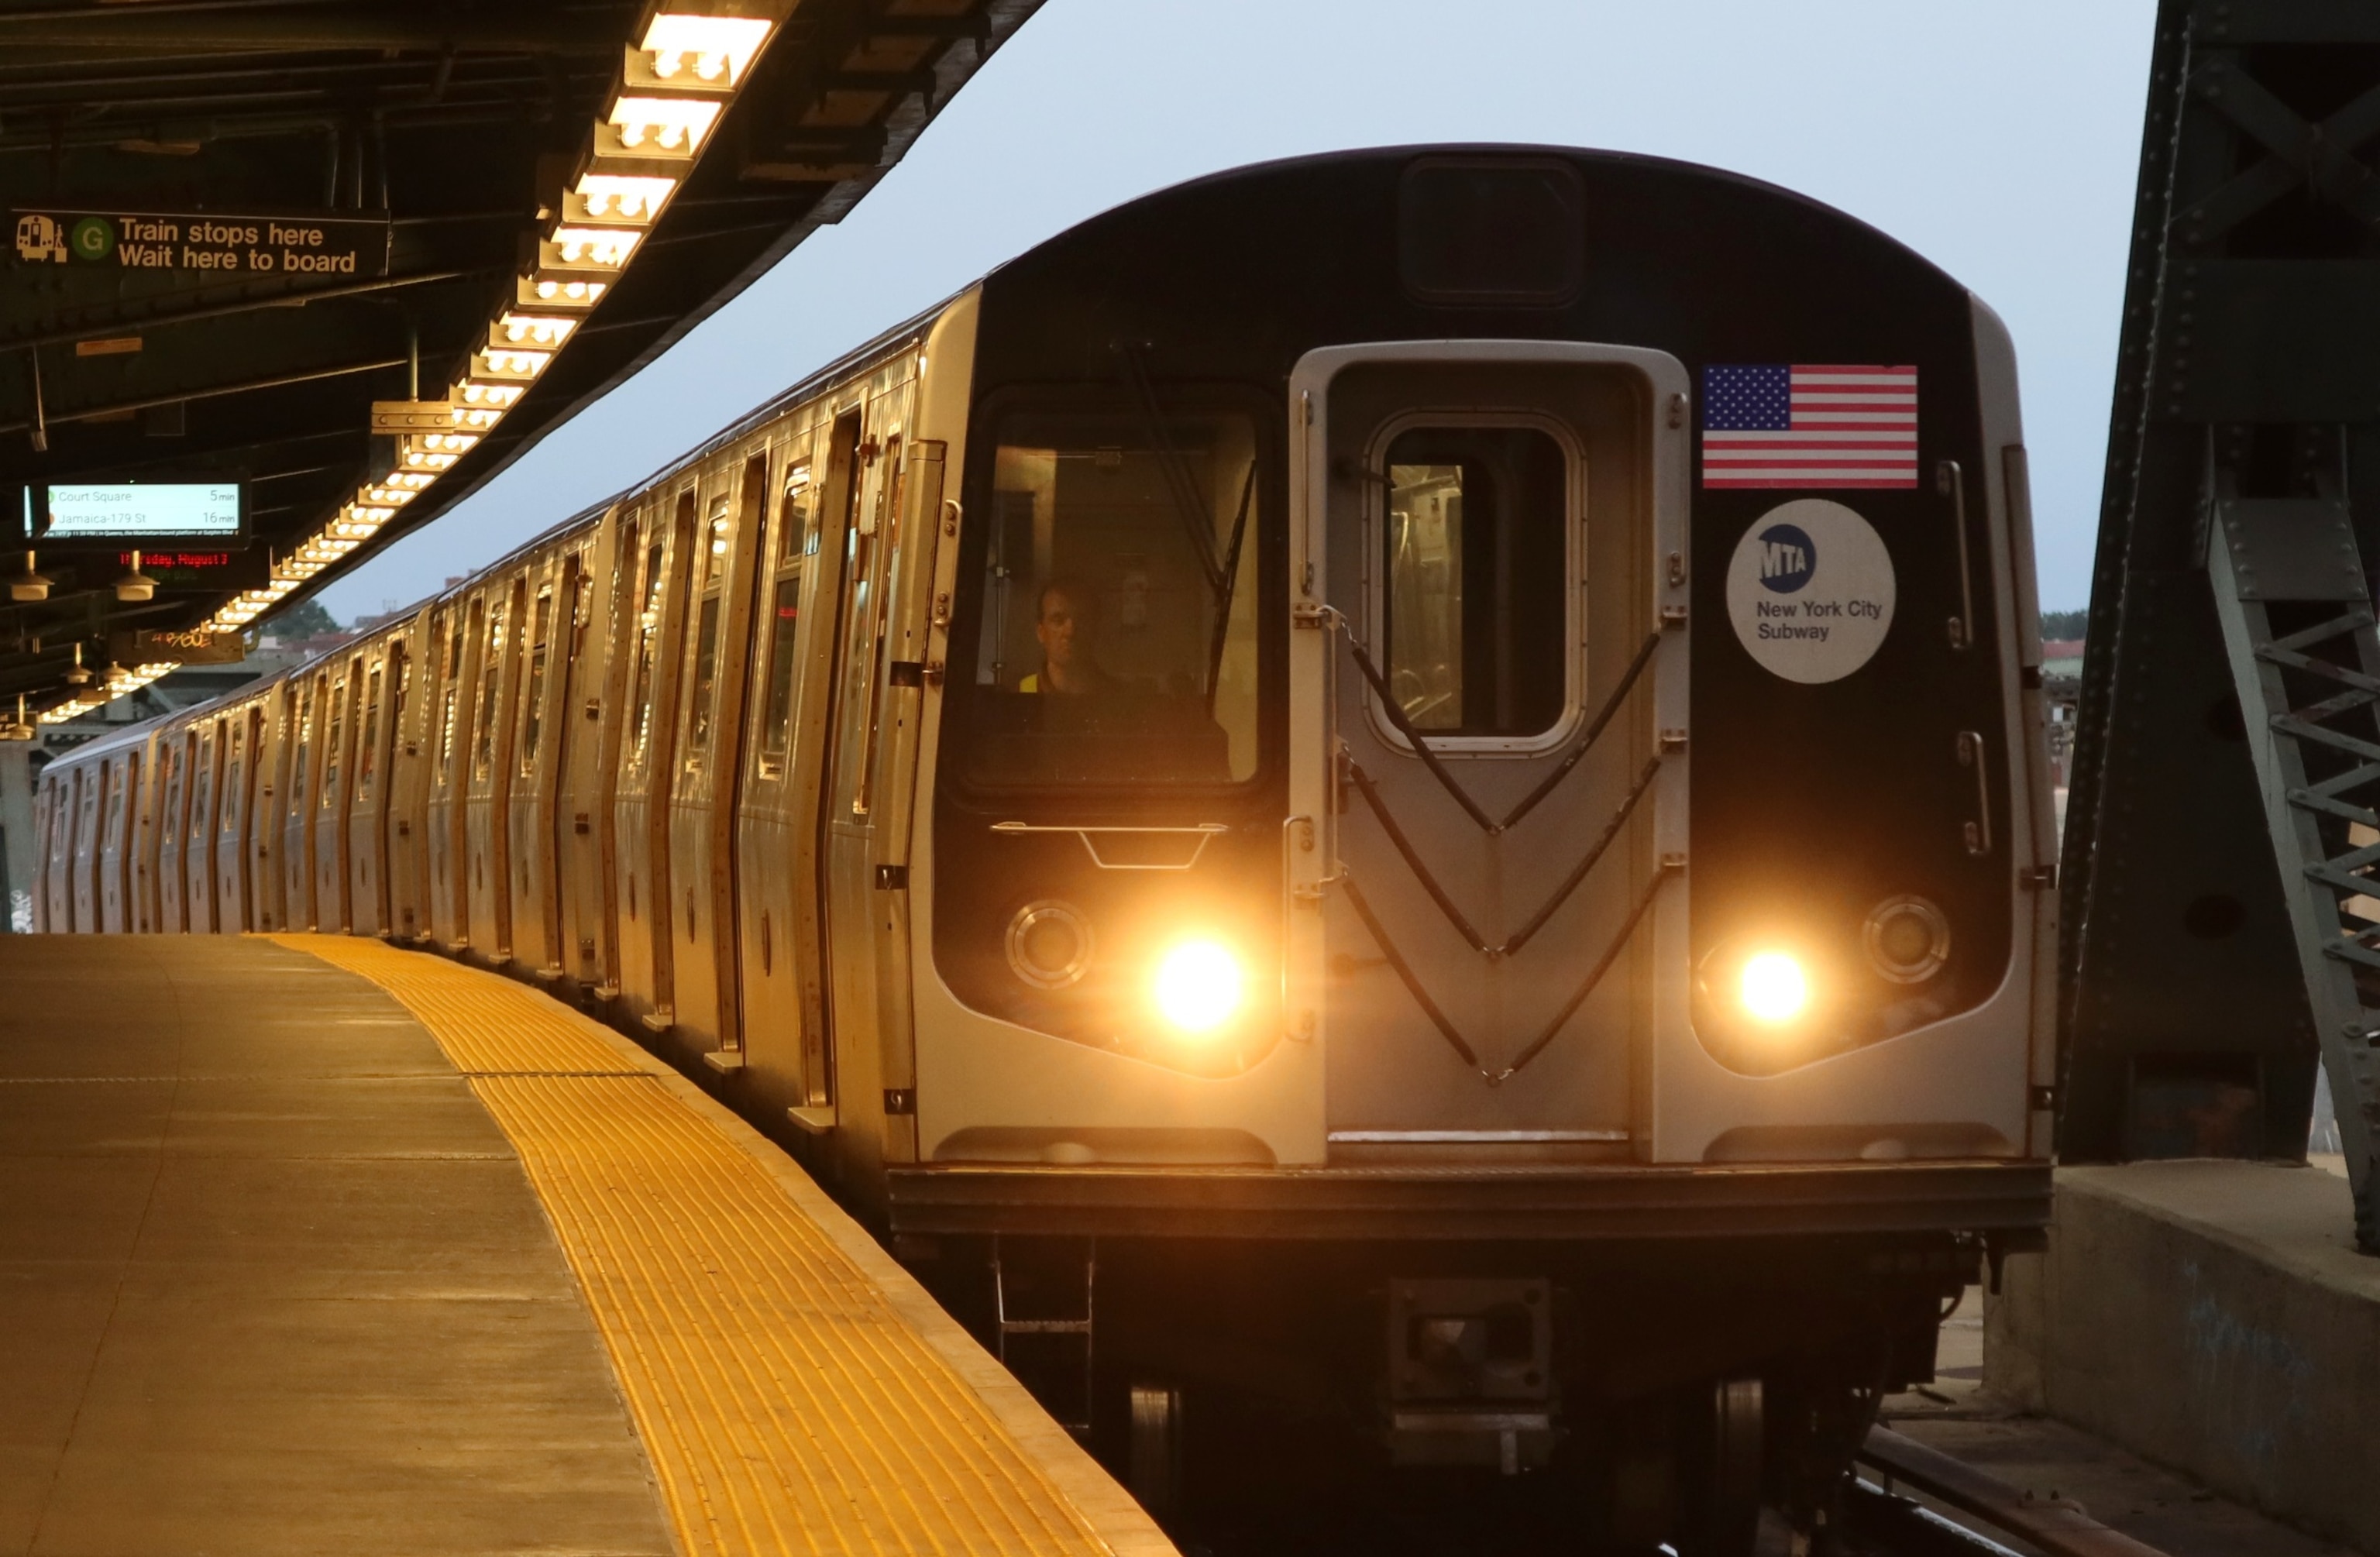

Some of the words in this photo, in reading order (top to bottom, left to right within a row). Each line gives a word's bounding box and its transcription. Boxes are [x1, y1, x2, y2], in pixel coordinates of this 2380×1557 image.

[82, 226, 103, 251] G
[119, 218, 178, 242] Train
[188, 222, 259, 248] stops
[269, 222, 323, 246] here
[119, 243, 173, 267] Wait
[183, 246, 238, 269] here
[249, 249, 273, 270] to
[284, 249, 356, 273] board
[58, 491, 90, 502] Court
[92, 491, 132, 504] Square
[210, 490, 218, 501] 5
[58, 513, 132, 524] Jamaica-179
[135, 513, 146, 524] St
[203, 512, 218, 524] 16
[1758, 540, 1807, 579] MTA
[1757, 601, 1797, 617] New
[1803, 601, 1842, 617] York
[1848, 600, 1882, 620] City
[1758, 622, 1829, 642] Subway
